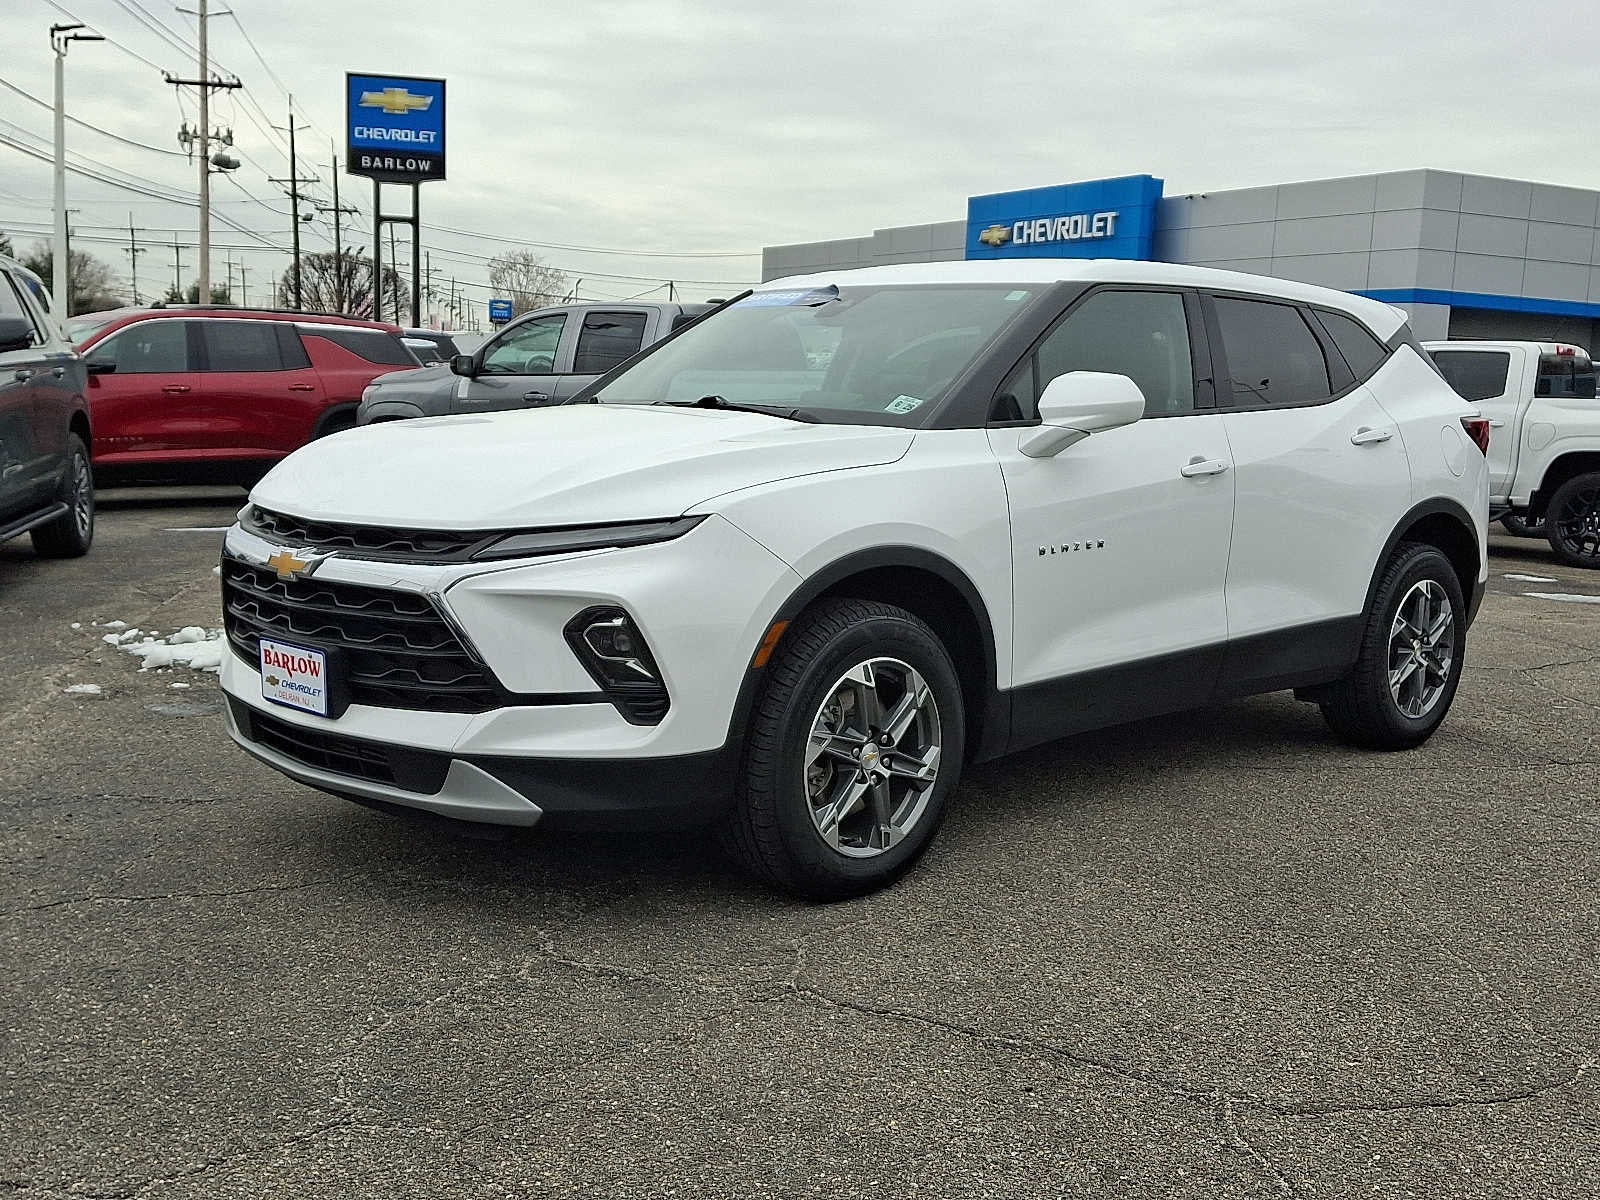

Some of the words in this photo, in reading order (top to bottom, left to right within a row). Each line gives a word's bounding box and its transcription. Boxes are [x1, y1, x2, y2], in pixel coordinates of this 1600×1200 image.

[354, 126, 437, 143] CHEVROLET
[361, 156, 432, 171] BARLOW
[1012, 211, 1119, 244] CHEVROLET
[1038, 539, 1105, 557] BLAZER
[263, 649, 320, 678] BARLOW
[281, 680, 322, 697] CHEVROLET
